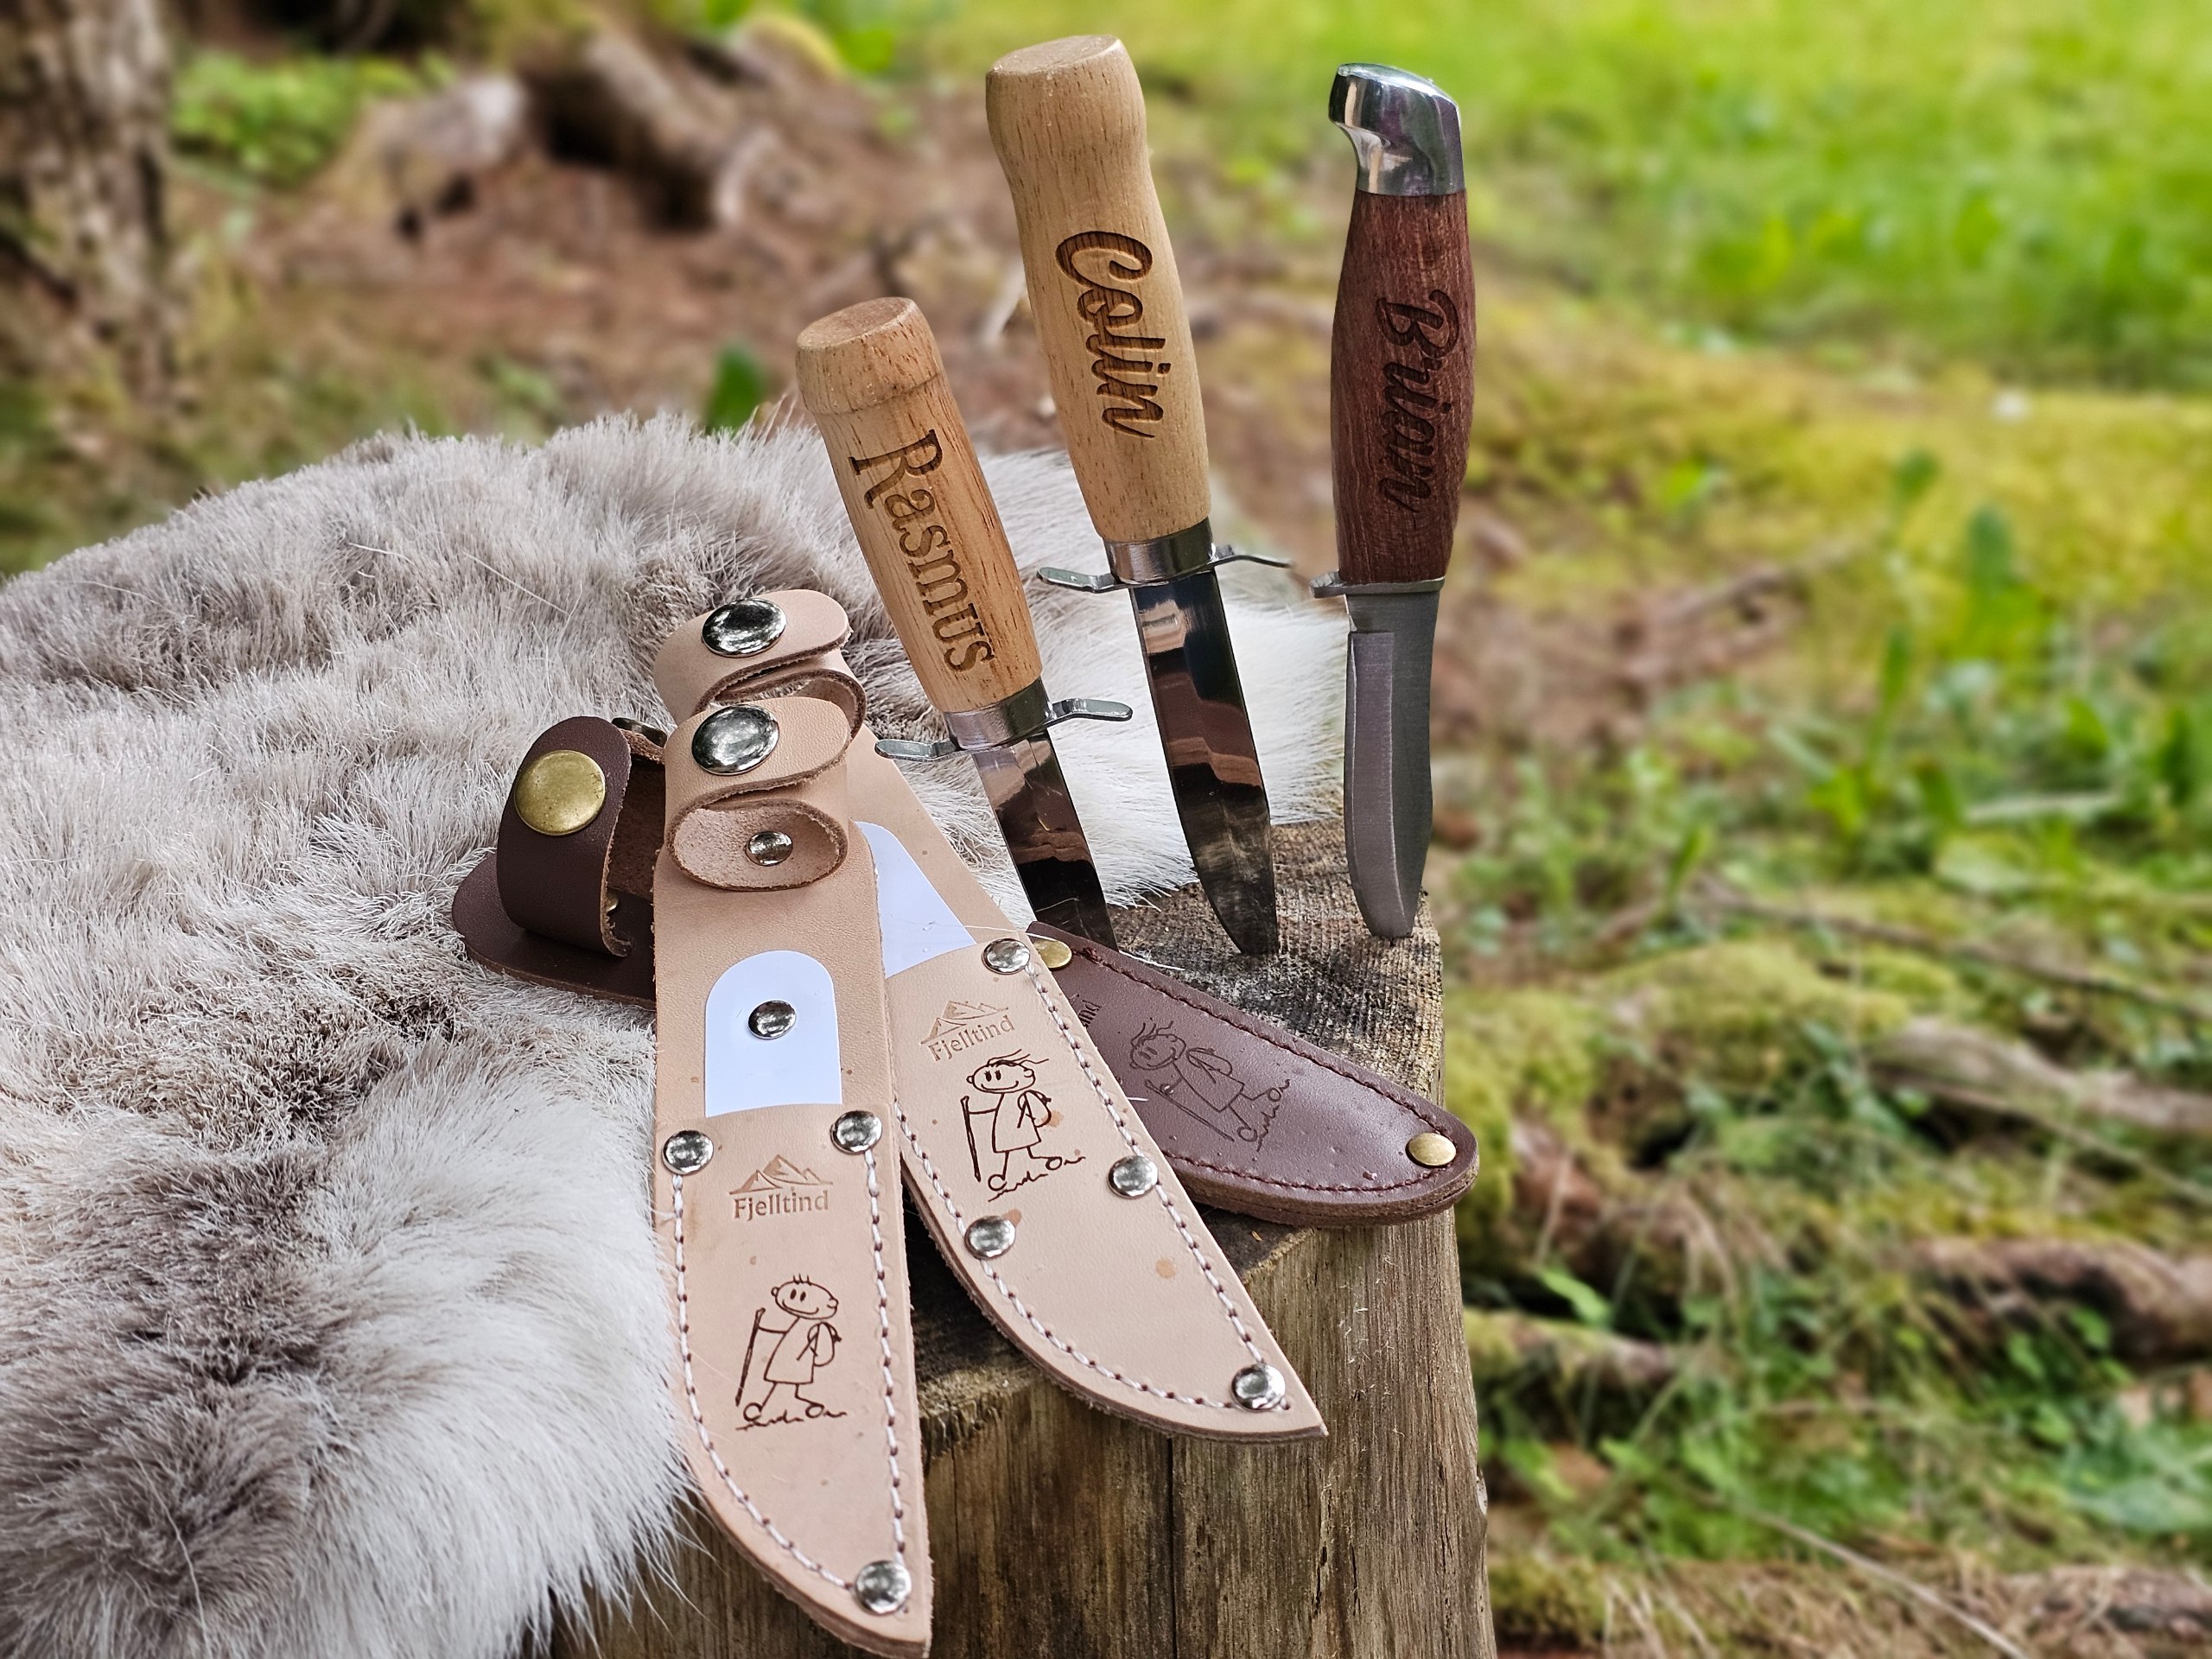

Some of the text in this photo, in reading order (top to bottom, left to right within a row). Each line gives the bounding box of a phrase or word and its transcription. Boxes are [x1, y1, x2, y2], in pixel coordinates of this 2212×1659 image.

[1054, 230, 1167, 439] Colin
[1375, 289, 1460, 512] Brian
[847, 429, 995, 672] Rasmus
[927, 1014, 1015, 1062] Fjelltind
[733, 1189, 830, 1222] Fjelltind
